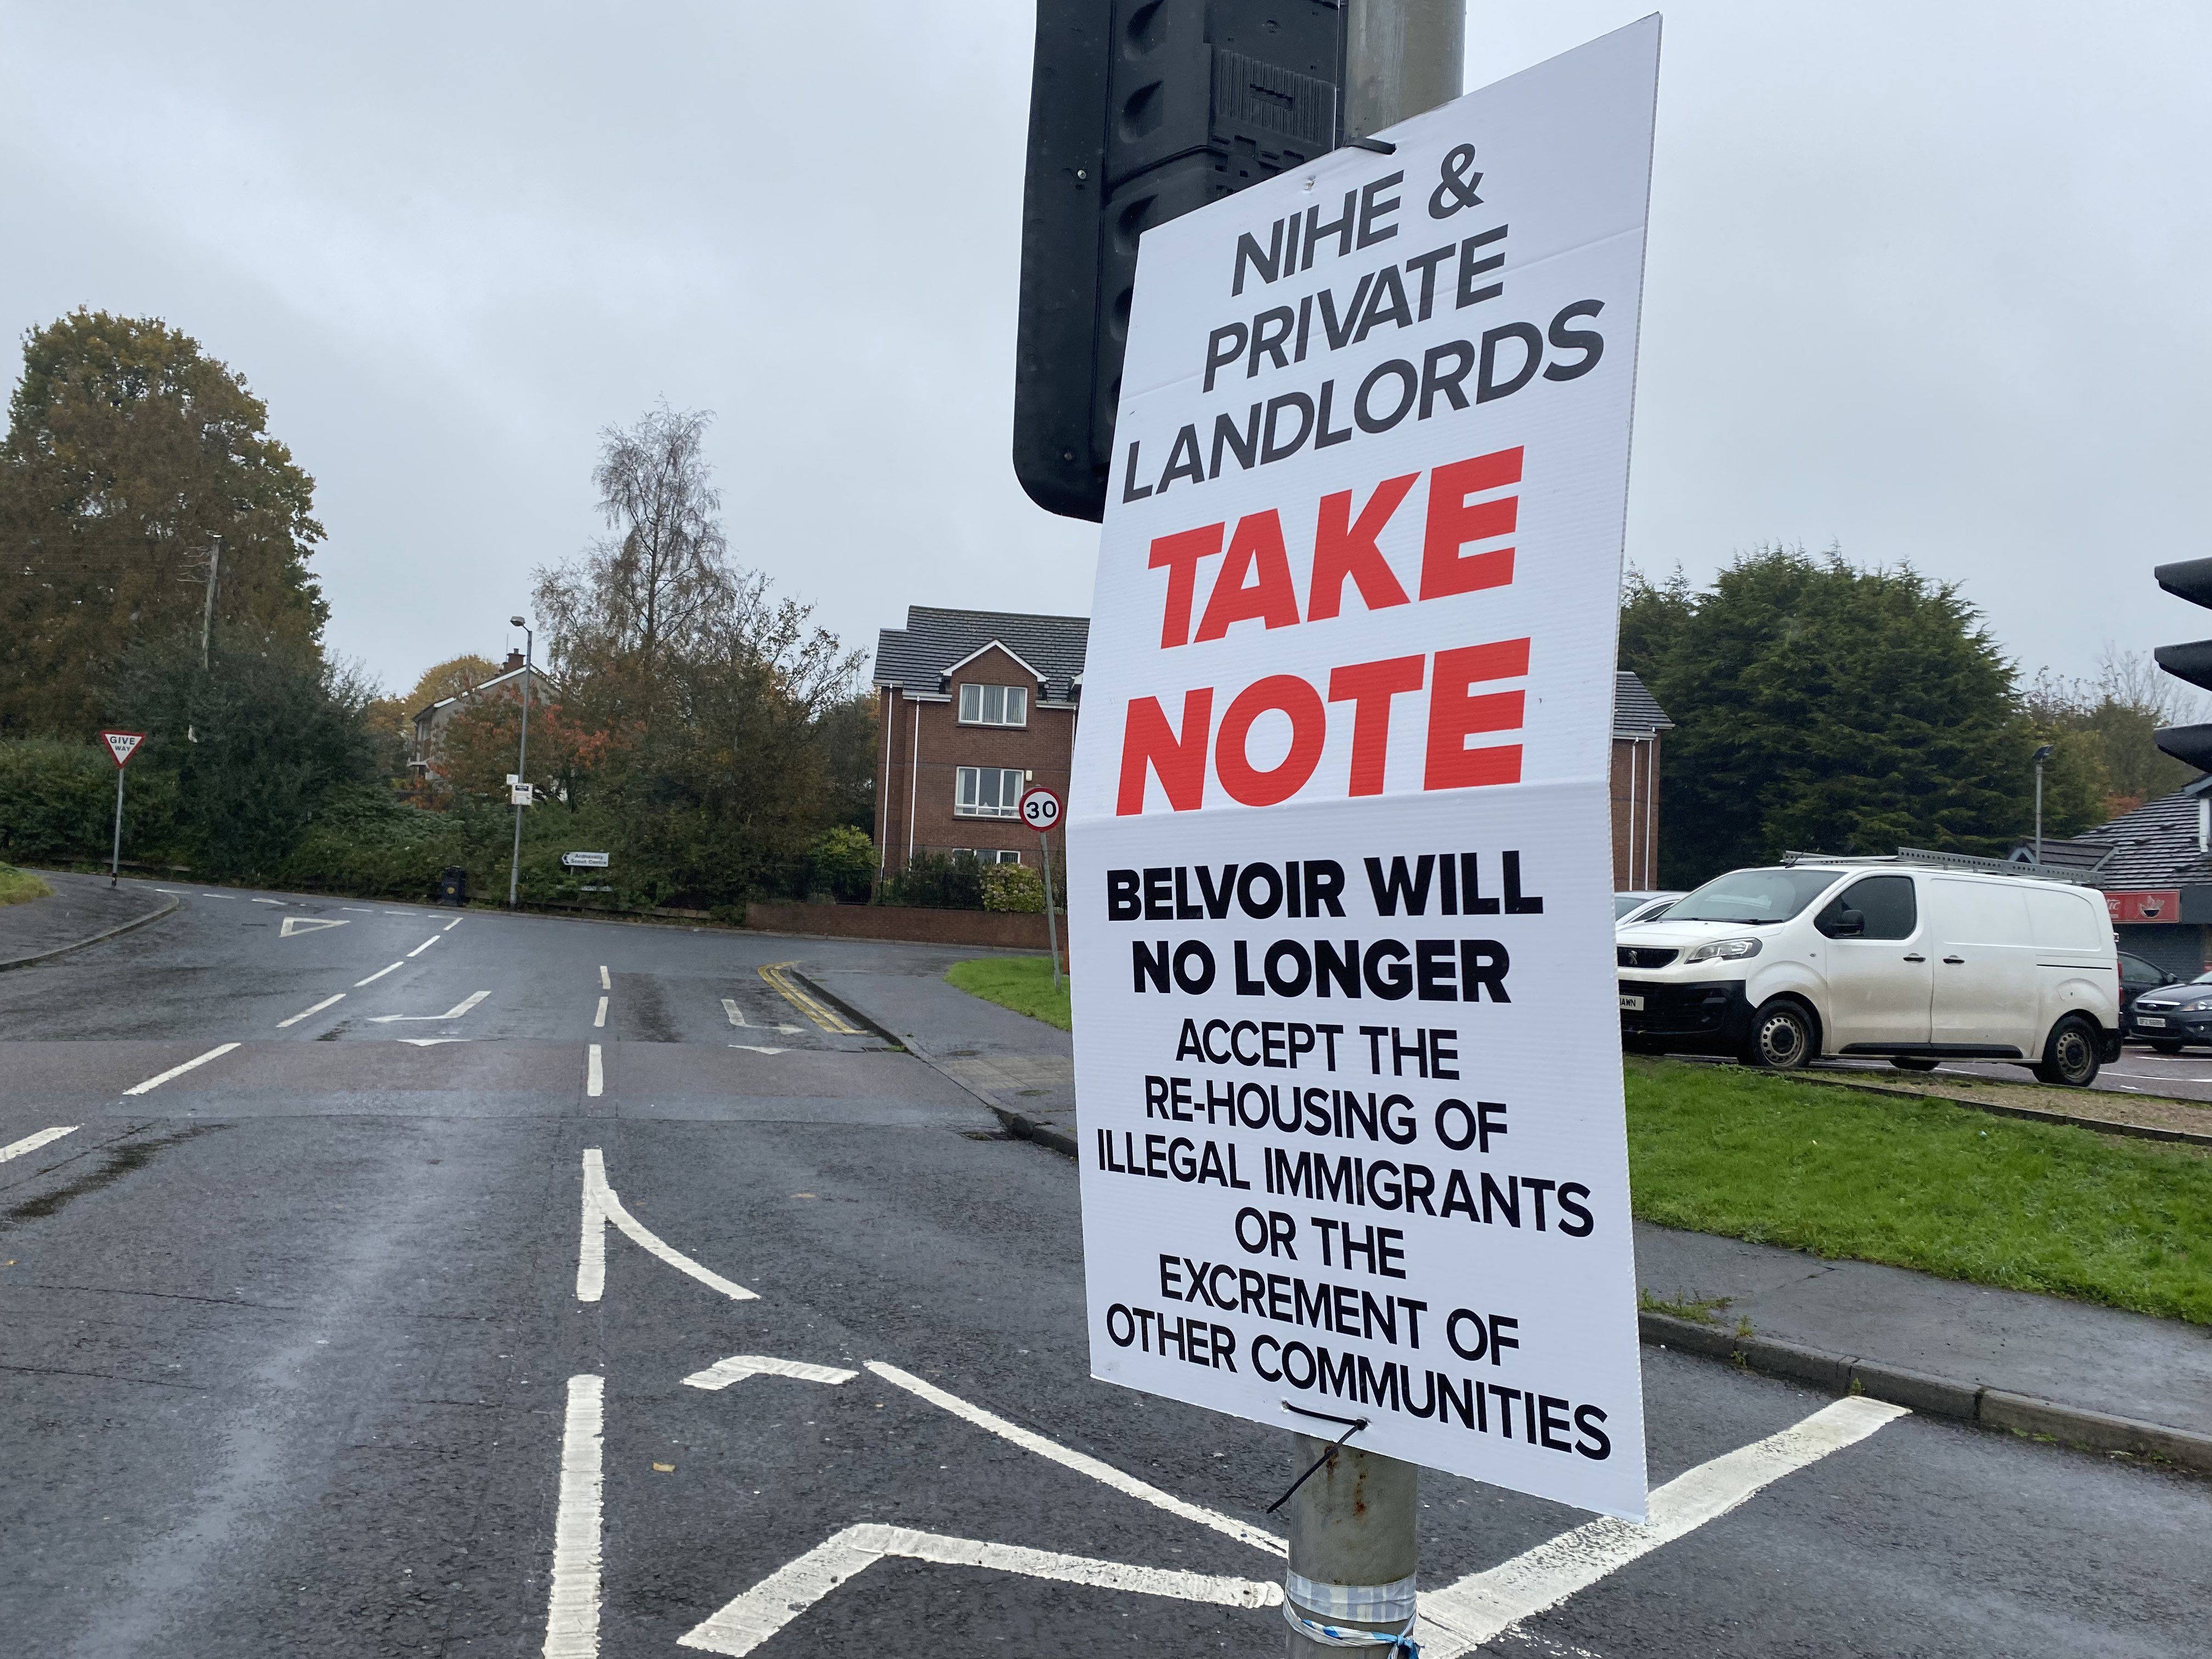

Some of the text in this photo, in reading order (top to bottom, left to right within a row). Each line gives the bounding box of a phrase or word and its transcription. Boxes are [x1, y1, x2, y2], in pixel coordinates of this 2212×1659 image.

[1231, 143, 1485, 298] NIHE &
[1201, 223, 1509, 394] PRIVATE
[1121, 298, 1606, 505] LANDLORDS
[1147, 444, 1525, 650] TAKE
[110, 736, 135, 744] GIVE
[1115, 636, 1532, 817] NOTE
[1026, 800, 1057, 819] 30
[1106, 849, 1544, 922] BELVOIR WILL
[1131, 938, 1513, 1004] NO LONGER
[1175, 1017, 1460, 1081] ACCEPT THE
[1144, 1074, 1508, 1154] RE-HOUSING OF
[1097, 1127, 1595, 1238] ILLEGAL IMMIGRANTS
[1234, 1206, 1407, 1280] OR THE
[1159, 1252, 1520, 1368] EXCREMENT OF
[1105, 1302, 1612, 1461] OTHER COMMUNITIES
